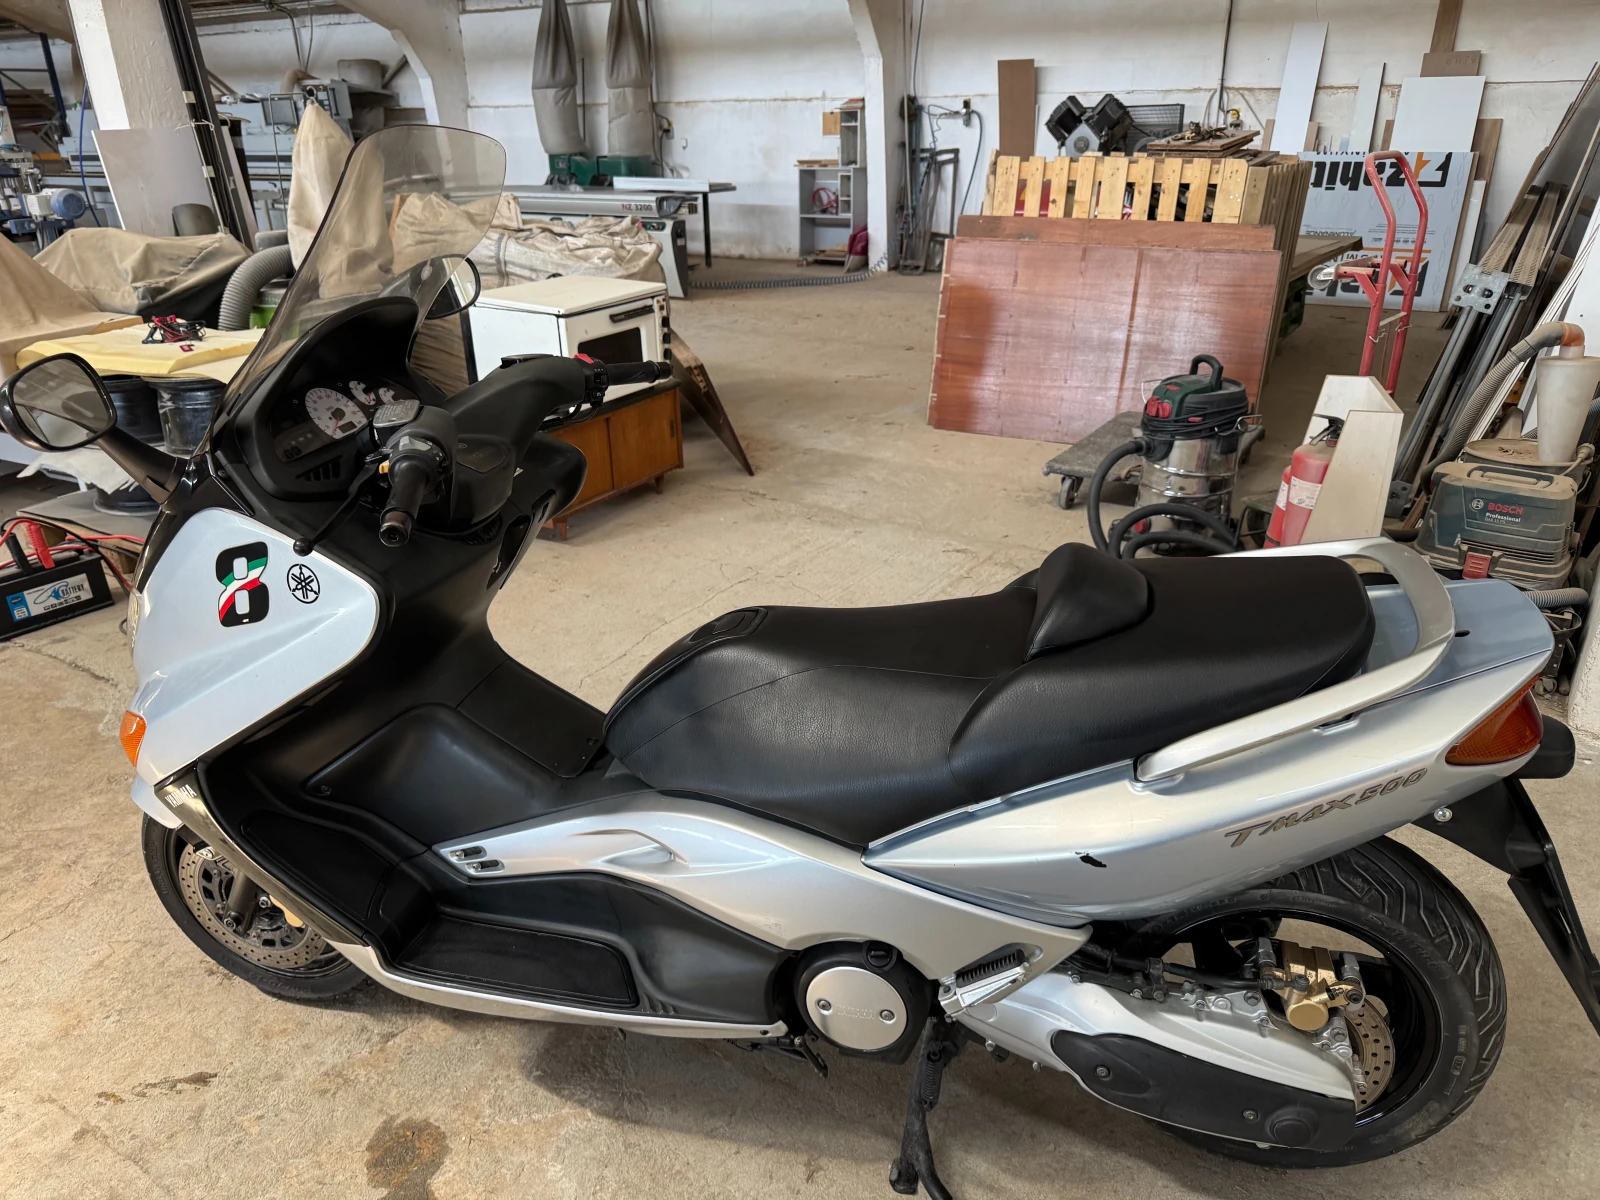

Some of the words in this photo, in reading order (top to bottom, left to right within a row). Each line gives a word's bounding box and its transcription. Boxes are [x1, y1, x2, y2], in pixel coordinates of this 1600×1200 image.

[634, 204, 653, 212] 3200
[1488, 503, 1524, 514] BOSCH
[1486, 513, 1520, 522] Professional
[60, 583, 85, 597] BATTERY
[215, 541, 270, 628] 8
